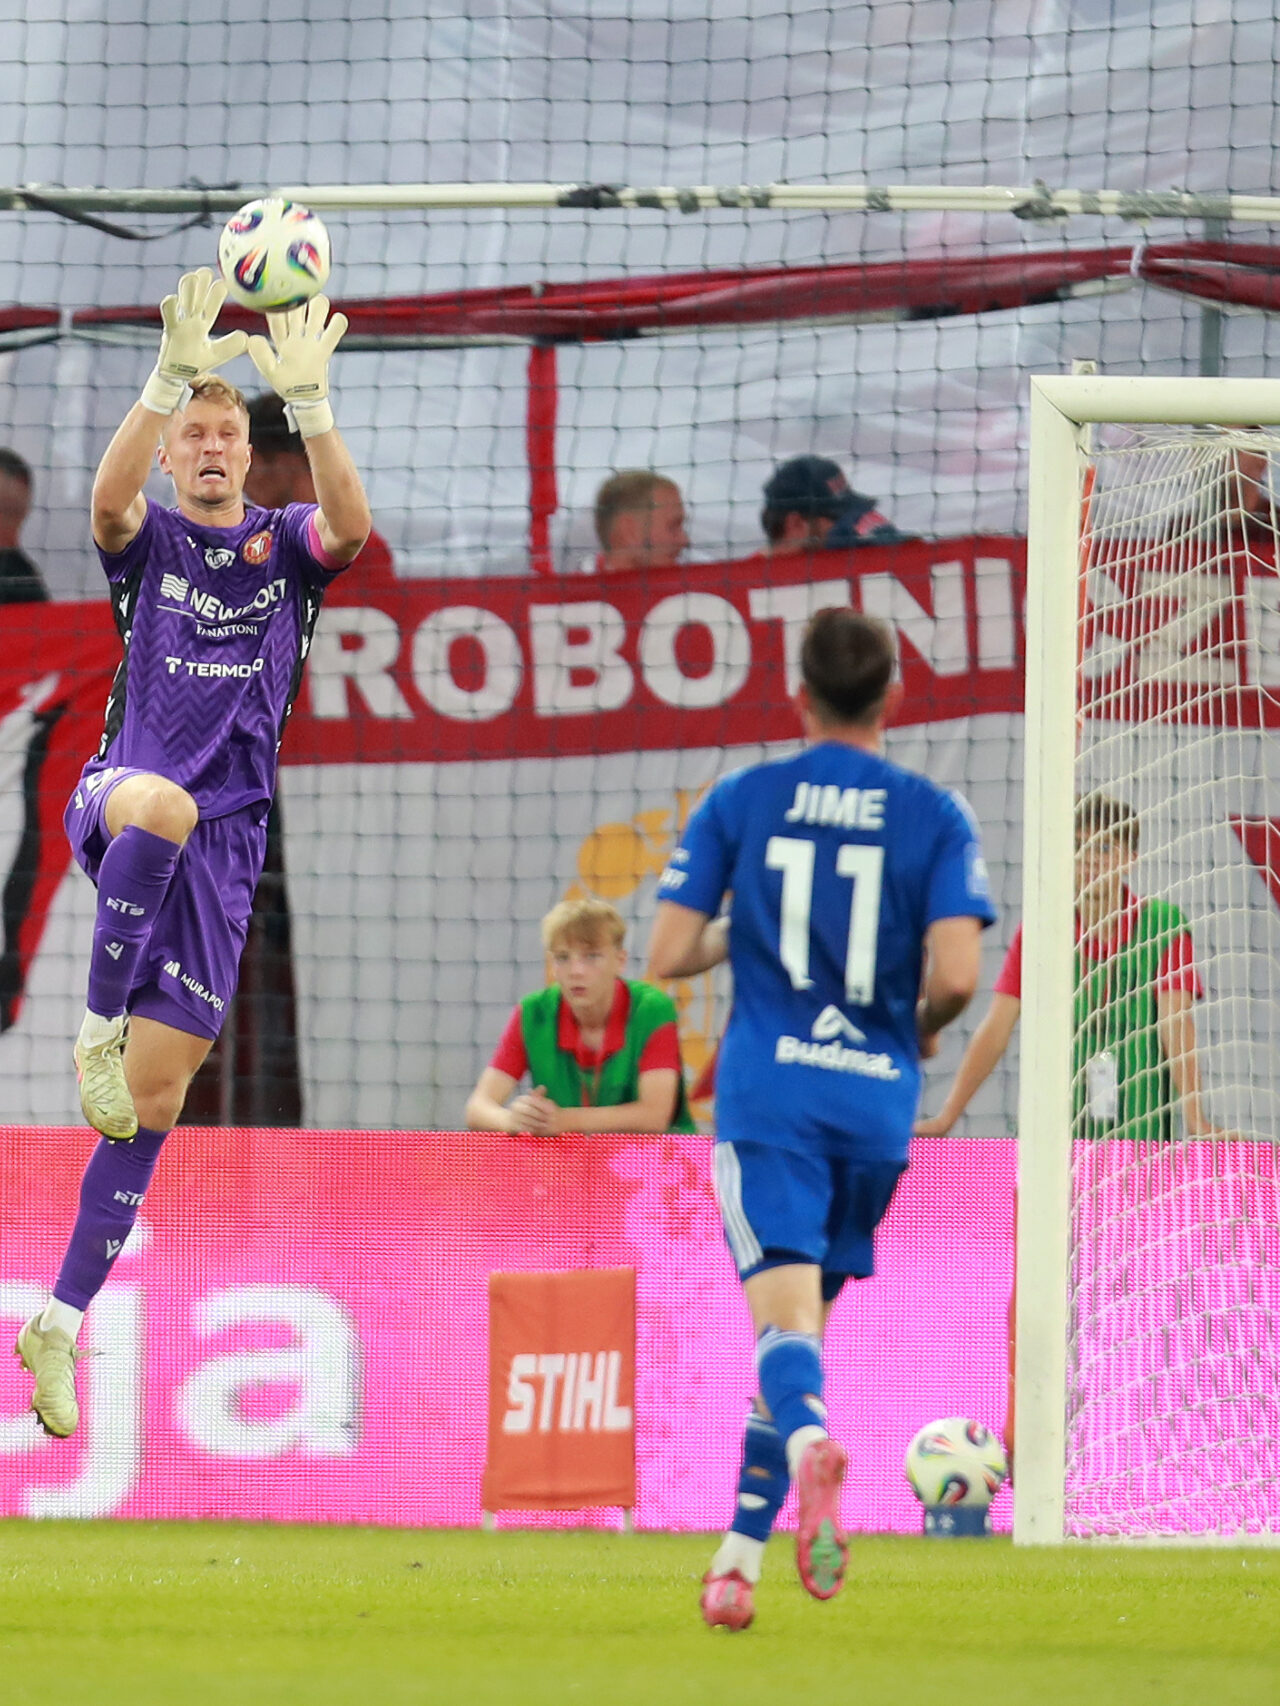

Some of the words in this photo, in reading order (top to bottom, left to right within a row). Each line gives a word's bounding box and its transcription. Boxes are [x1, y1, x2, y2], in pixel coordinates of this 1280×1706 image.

[785, 782, 887, 829] JIME
[106, 897, 145, 916] RTS
[765, 836, 884, 1006] 11
[180, 973, 225, 1012] MURAPOL
[502, 1350, 632, 1433] STIHL
